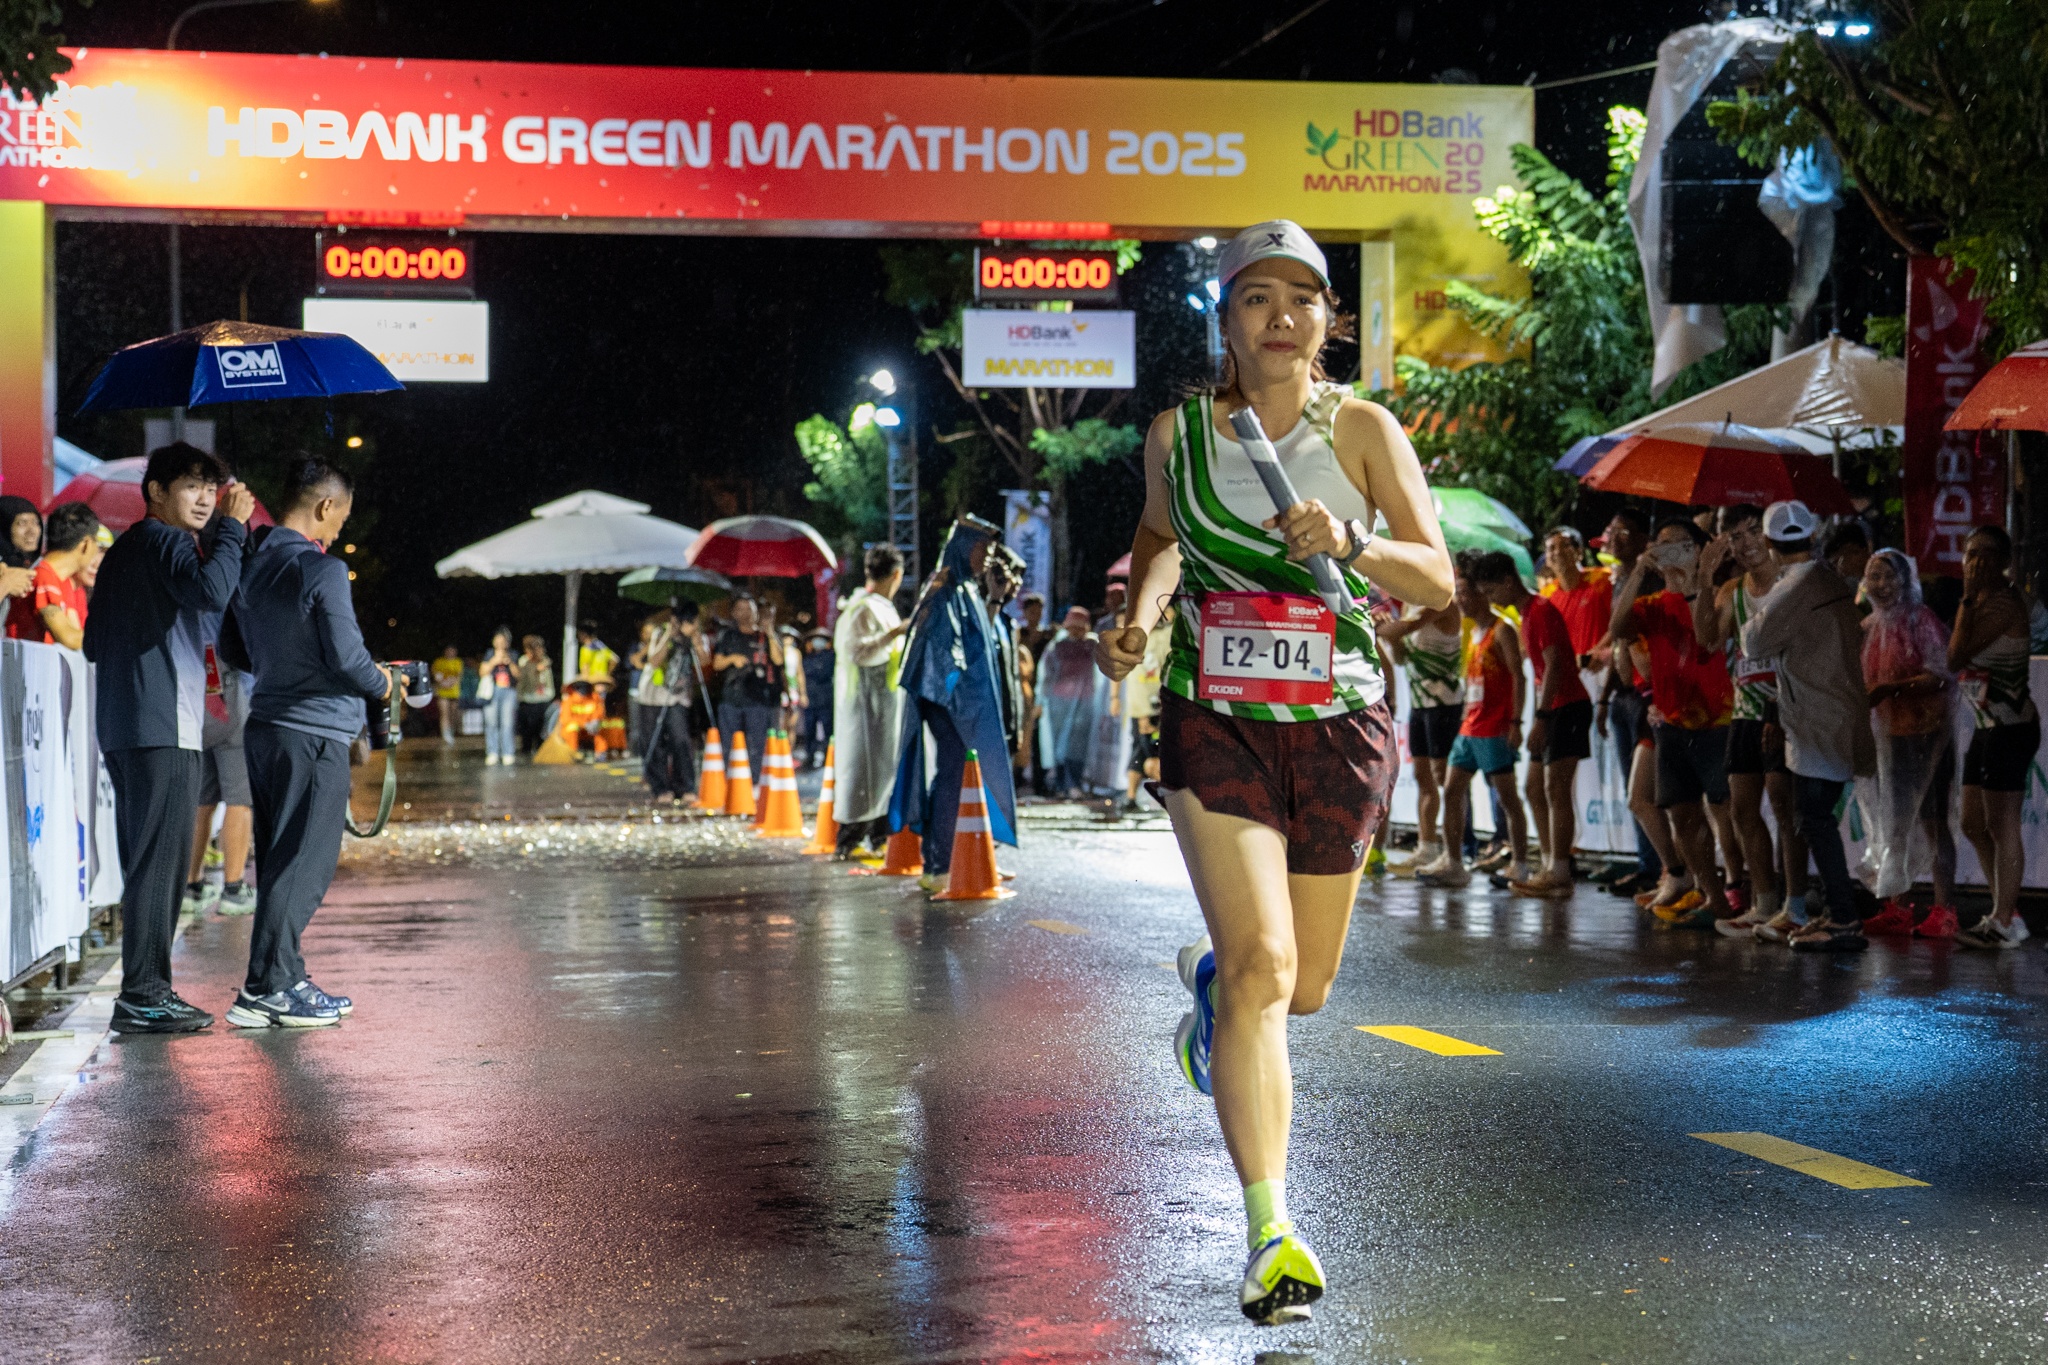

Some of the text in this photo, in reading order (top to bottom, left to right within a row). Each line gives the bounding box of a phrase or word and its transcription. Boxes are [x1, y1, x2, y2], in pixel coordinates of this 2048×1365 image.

[1354, 109, 1484, 139] HDBank
[207, 106, 1247, 177] HDBANK GREEN MARATHON 2025
[1321, 135, 1485, 172] GREEN 20
[1303, 169, 1482, 194] MARATHON 25
[325, 245, 466, 279] 0:00:00
[981, 256, 1111, 289] 0:00:00
[1008, 325, 1072, 340] HDBank
[221, 349, 278, 371] OM
[225, 368, 280, 378] SYSTEM
[985, 358, 1114, 377] MARATHON
[1222, 635, 1310, 671] E2-04
